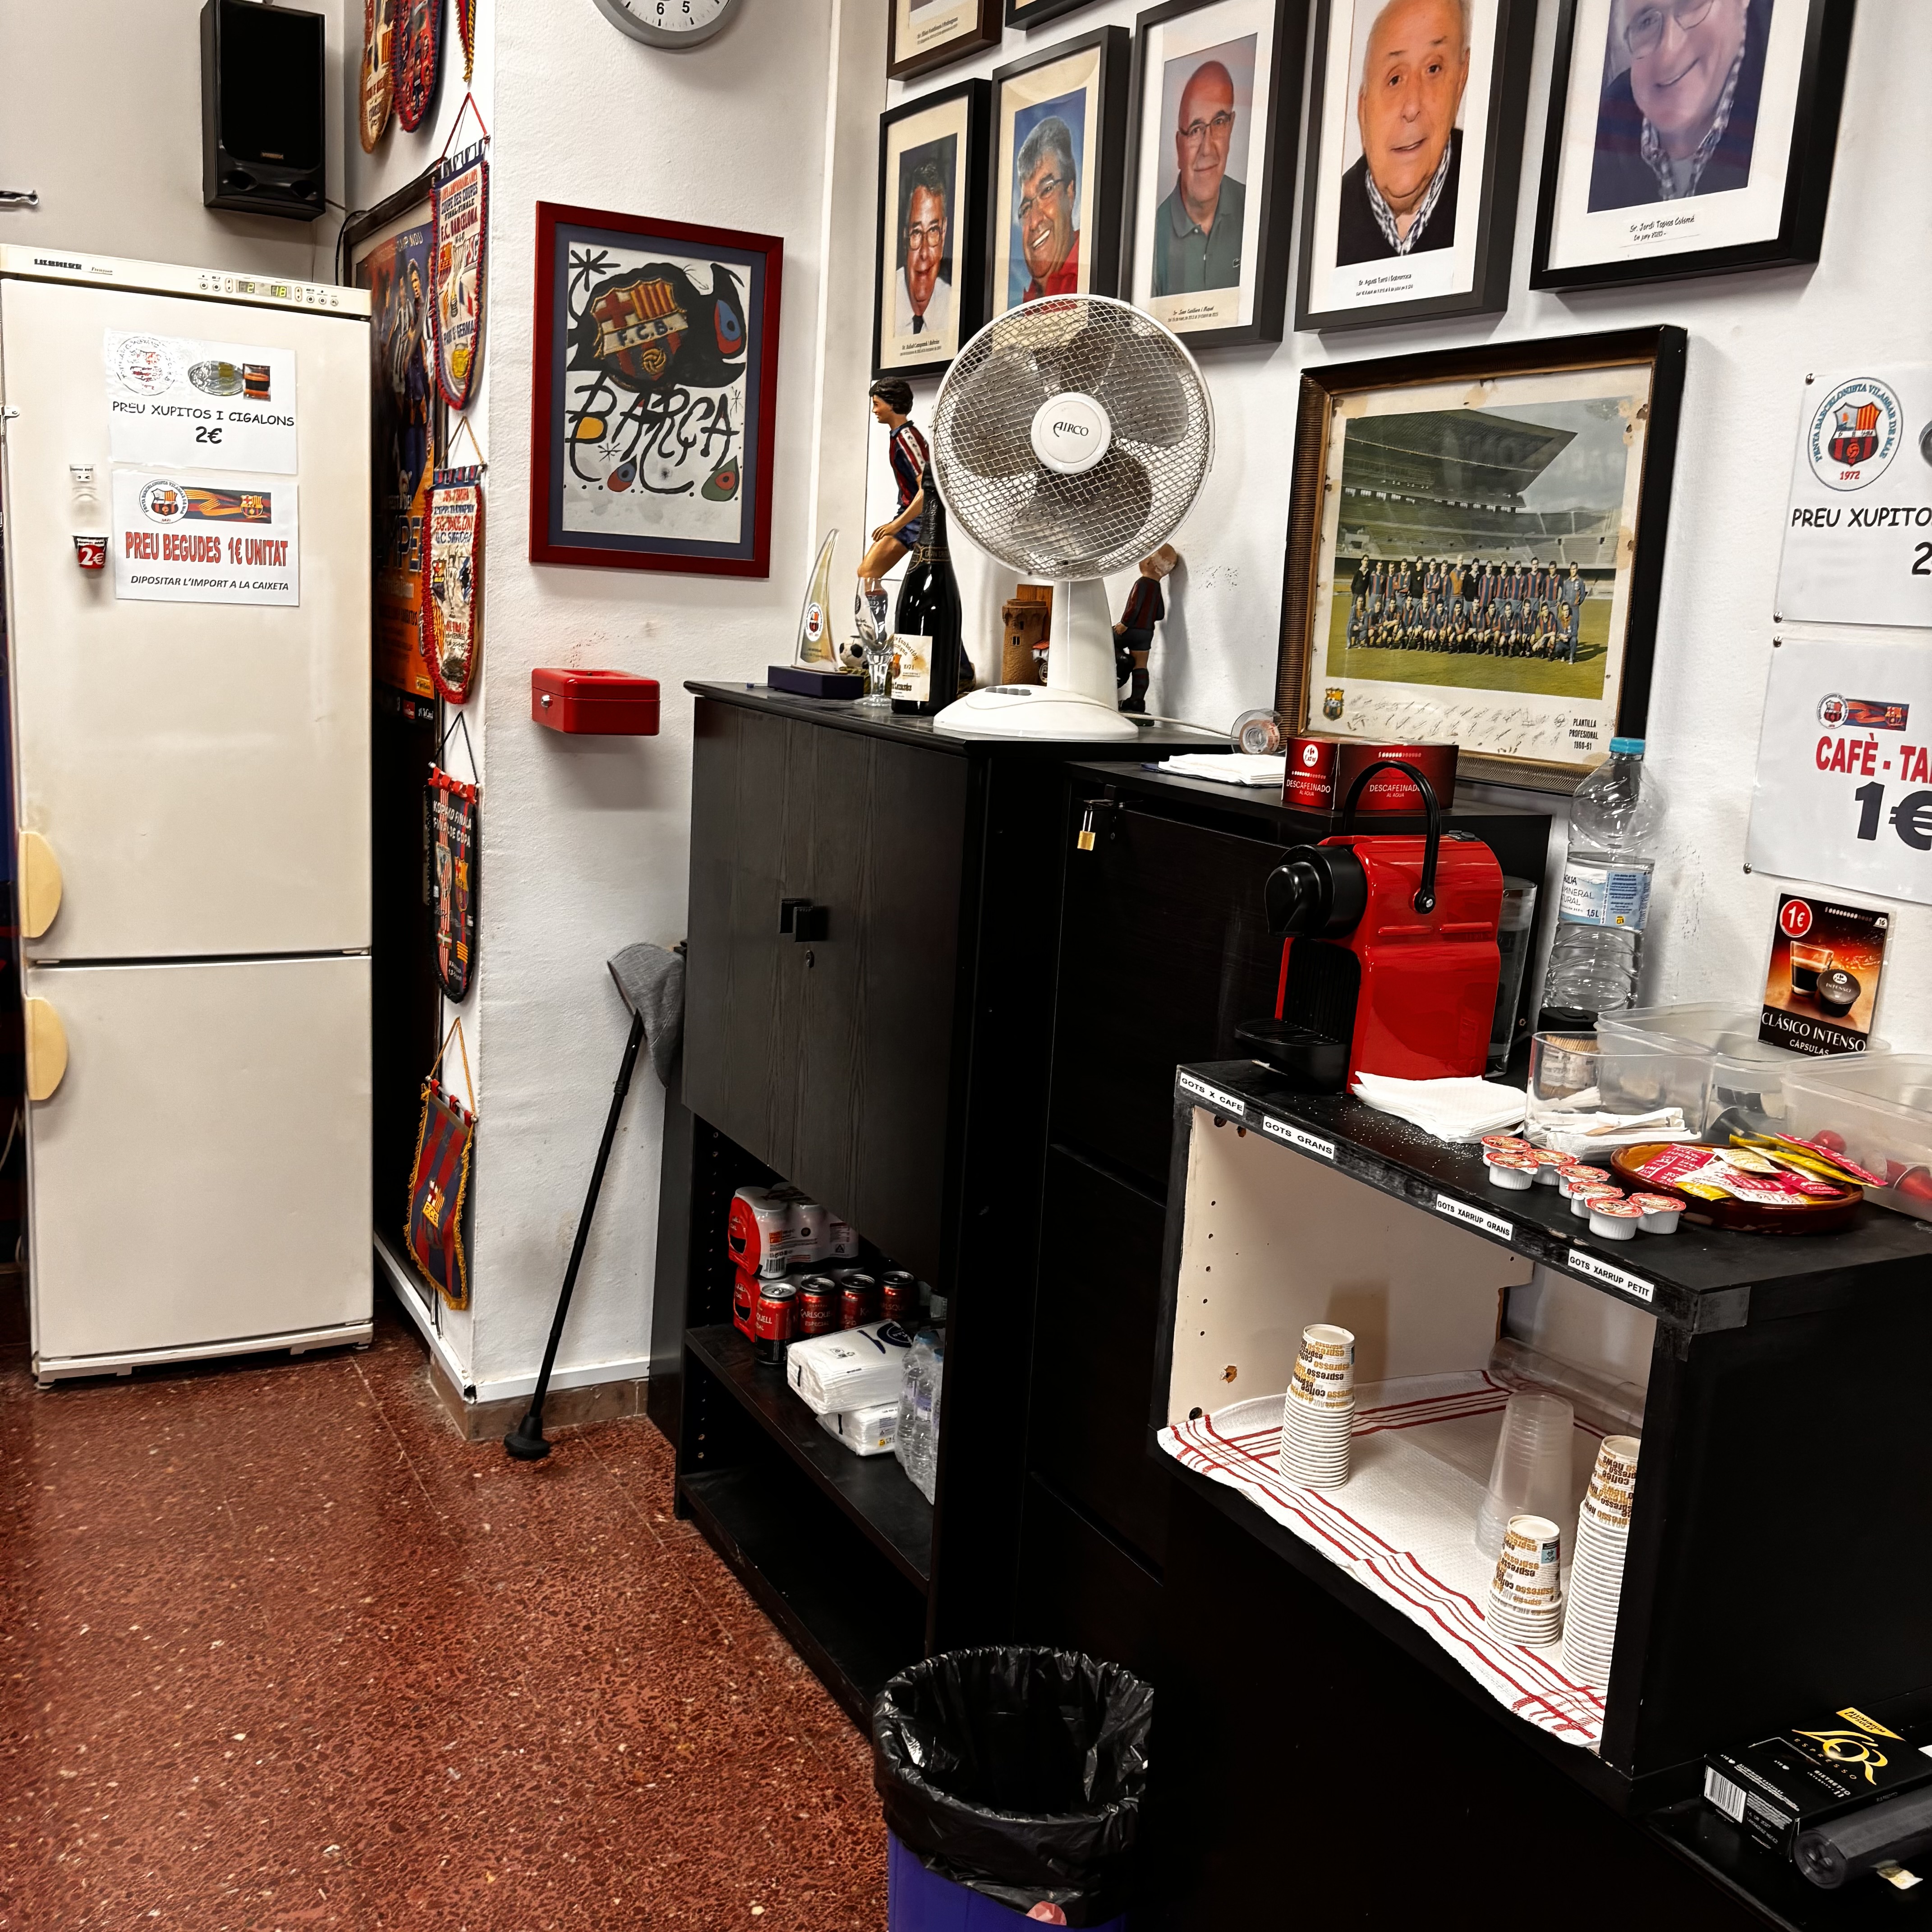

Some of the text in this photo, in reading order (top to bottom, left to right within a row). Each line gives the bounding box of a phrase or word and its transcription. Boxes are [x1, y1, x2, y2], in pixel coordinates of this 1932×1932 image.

[657, 1, 690, 14] 6 5
[451, 206, 478, 237] BARCELONA
[247, 283, 255, 293] 2
[276, 286, 287, 297] 18
[113, 401, 294, 427] PREU XUPITOS I CIGALONS
[195, 426, 222, 444] 2€
[1053, 422, 1089, 437] AIRCO
[1840, 470, 1860, 480] 1972
[1791, 507, 1932, 528] PREU XUPITO
[79, 547, 104, 566] 2€
[125, 531, 288, 567] PREU BEGUDES 1€ UNITAT
[1912, 542, 1932, 575] 2
[131, 575, 181, 586] DIPOSITAR
[183, 578, 229, 588] L'IMPORT
[239, 580, 250, 589] LA
[253, 581, 289, 591] CAIXETA
[1573, 718, 1596, 727] PLANTILLA
[1569, 729, 1599, 740] PROFESIONAL
[1815, 732, 1879, 776] CAFÈ
[1900, 745, 1932, 784] TA
[1286, 779, 1331, 793] DESCAFEINADO
[1854, 781, 1932, 851] 1€
[457, 830, 471, 848] COPA
[1788, 906, 1805, 928] 1€
[1761, 1012, 1867, 1053] CLÁSICO INTENSO
[1789, 1039, 1829, 1055] CÁPSULAS
[1182, 1077, 1205, 1093] GOTS
[1219, 1096, 1243, 1112] CAFE
[1265, 1121, 1333, 1155] GOTS GRANS
[1437, 1200, 1510, 1237] GOTS XARRUP GRANS
[1570, 1256, 1650, 1297] GOTS XARRUP PETIT
[1307, 1368, 1344, 1380] espresso
[1301, 1383, 1325, 1397] coffee
[1603, 1456, 1624, 1471] news
[1602, 1470, 1629, 1486] coffee
[1610, 1467, 1636, 1479] presso
[1597, 1510, 1628, 1525] presso
